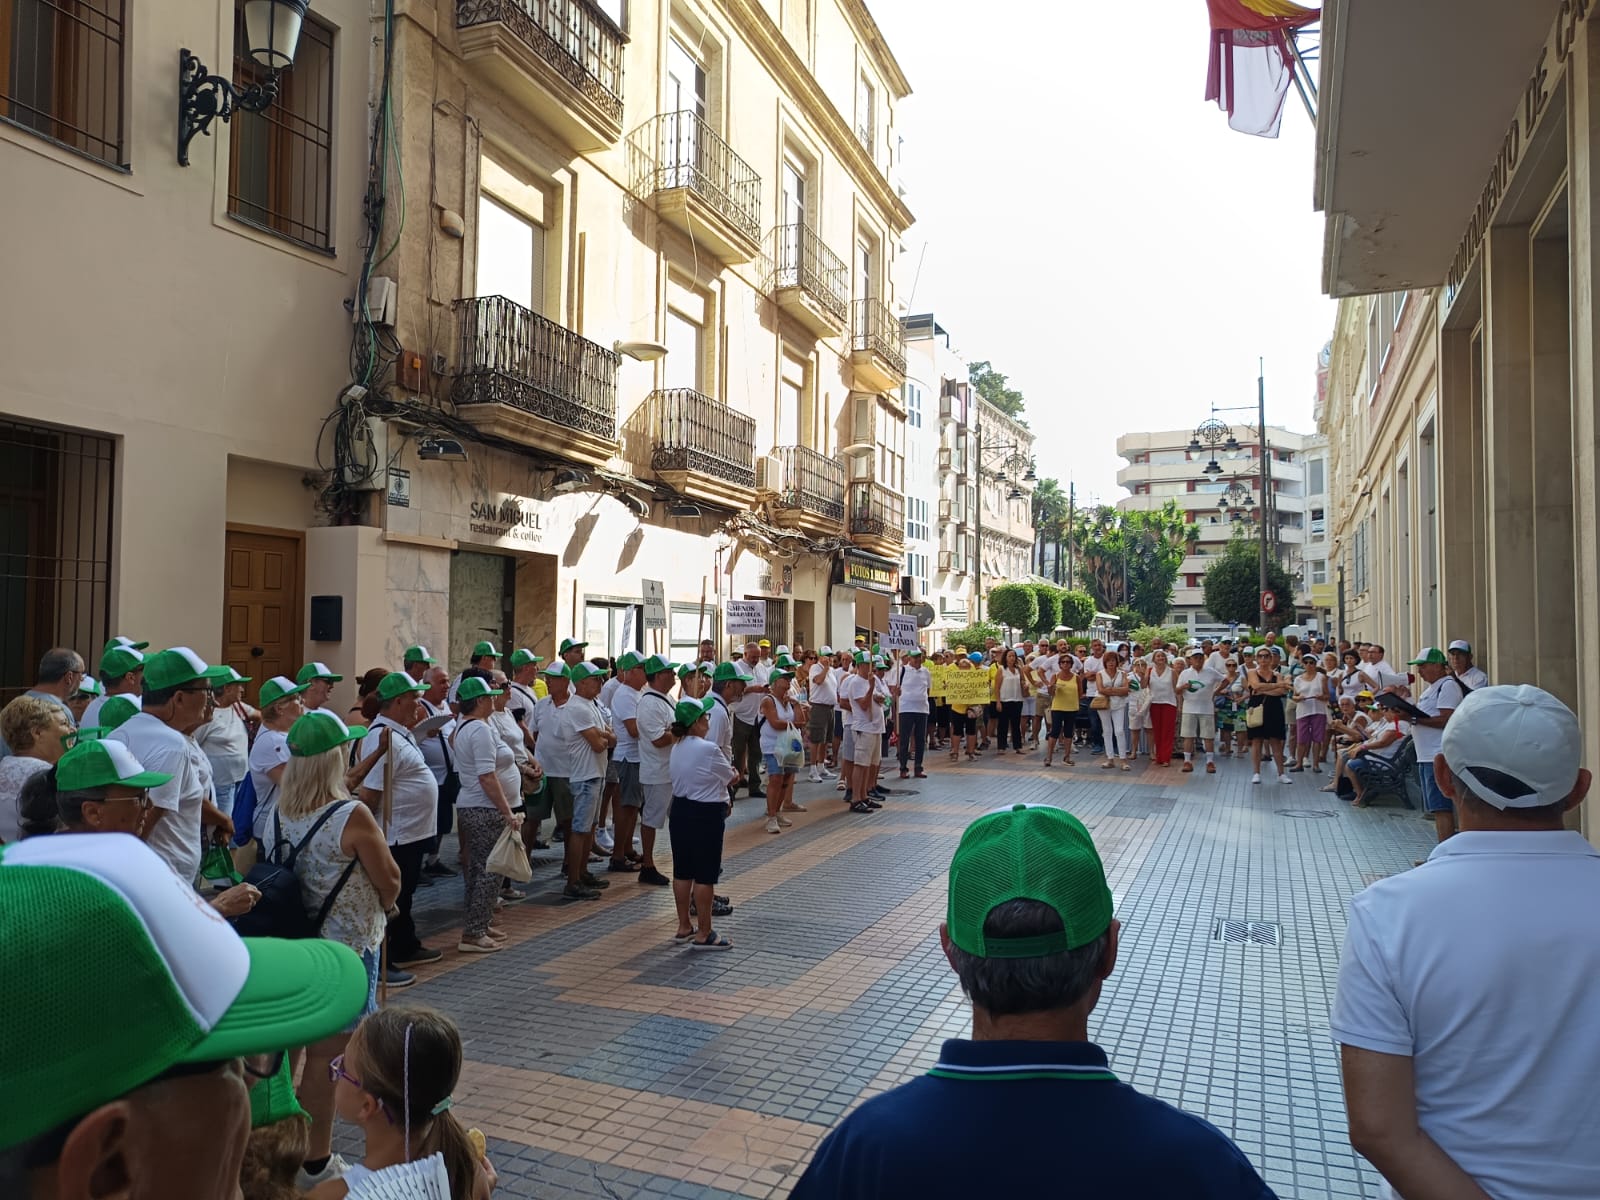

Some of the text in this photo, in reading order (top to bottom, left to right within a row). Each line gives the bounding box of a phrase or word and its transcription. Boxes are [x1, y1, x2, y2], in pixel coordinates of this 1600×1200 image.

[1525, 46, 1549, 140] DE
[470, 501, 542, 530] SAN MIGUEL
[470, 523, 543, 543] restaurant & coffee
[851, 563, 890, 583] FOTOS 1 HORA
[892, 630, 903, 638] LA
[895, 622, 914, 632] VIDA
[888, 637, 915, 647] MANGA
[945, 670, 988, 680] TRABAJADORES
